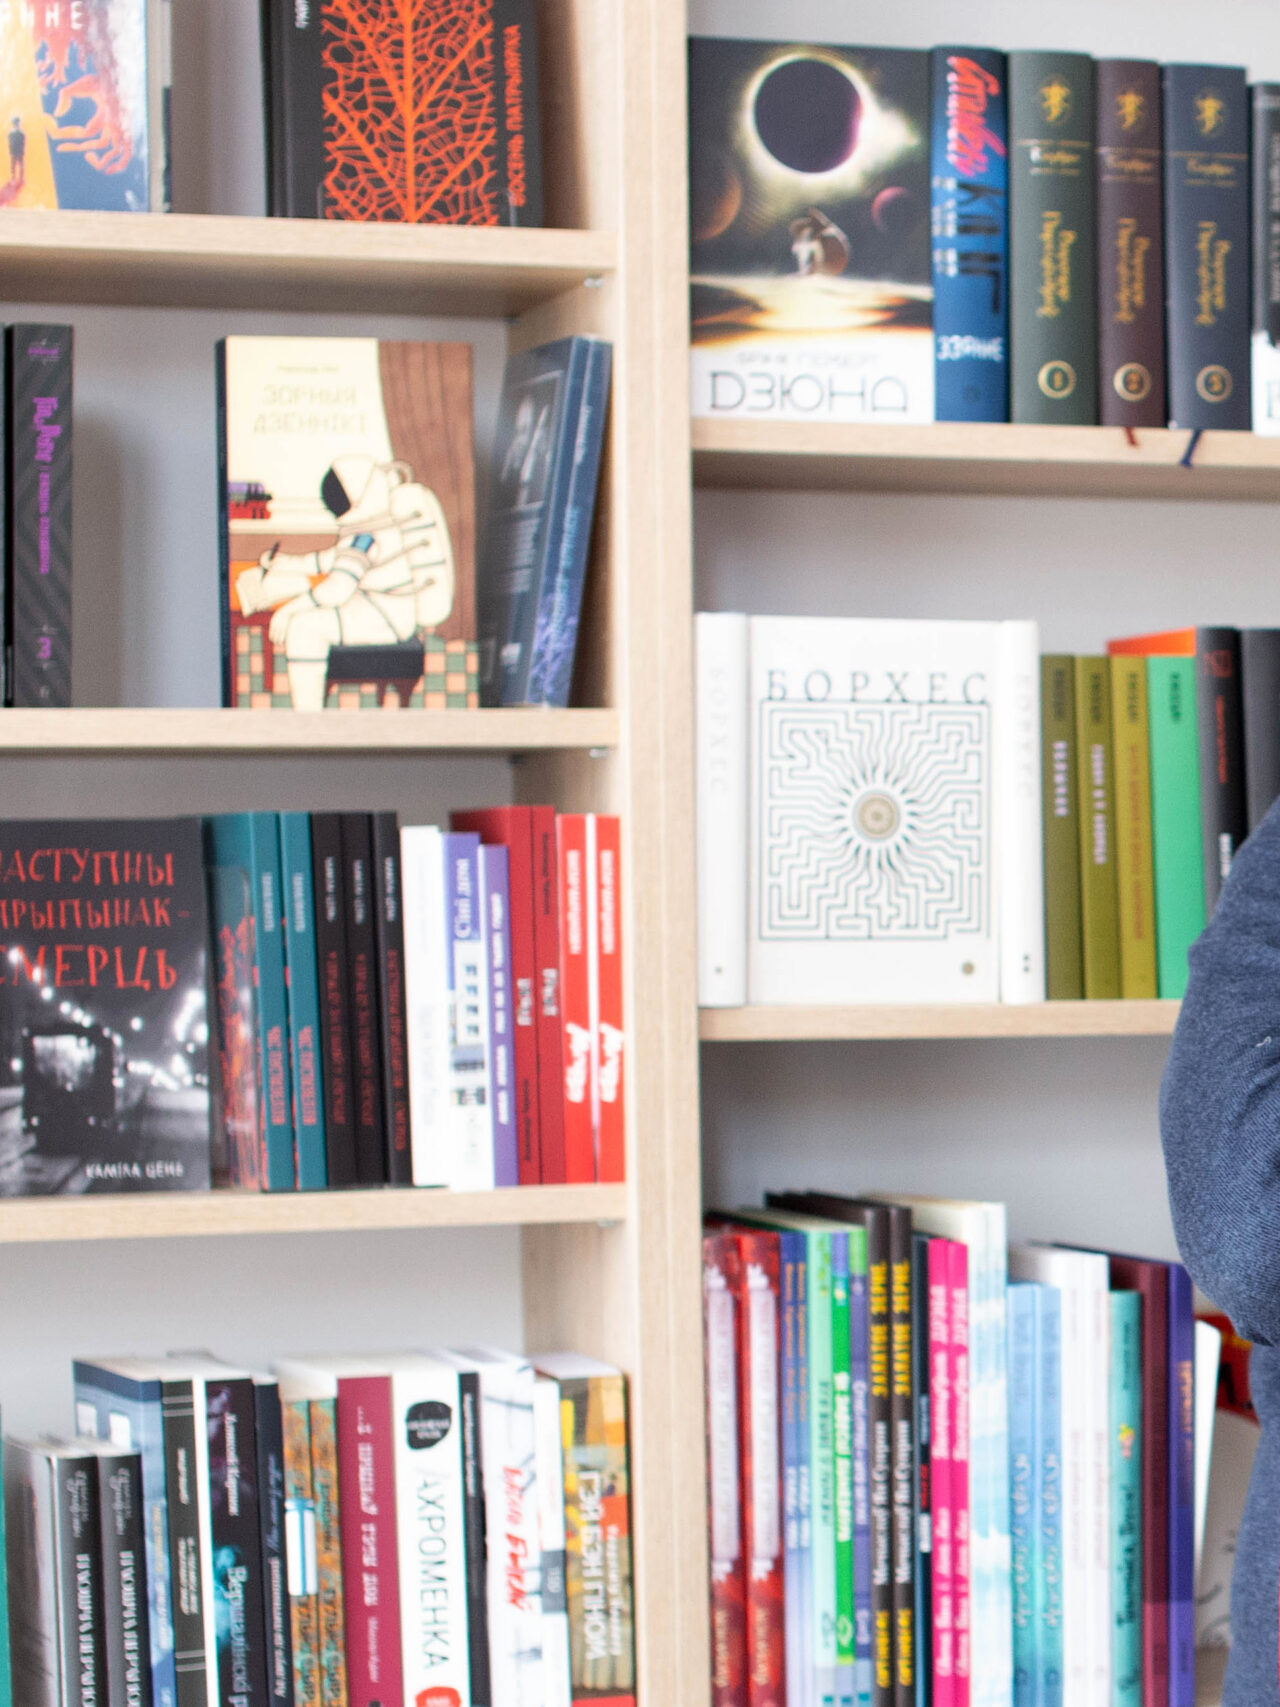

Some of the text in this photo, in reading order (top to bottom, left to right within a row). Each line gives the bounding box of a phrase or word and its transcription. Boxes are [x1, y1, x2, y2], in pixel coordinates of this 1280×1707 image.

[767, 669, 987, 703] БОРХЕС
[0, 847, 174, 887] АСТУПНЫ
[0, 945, 179, 991] МЕРЦЬ
[85, 1161, 184, 1179] КАМІЛА ЦЕНЬ
[414, 1479, 451, 1670] АХРОМЕНКА
